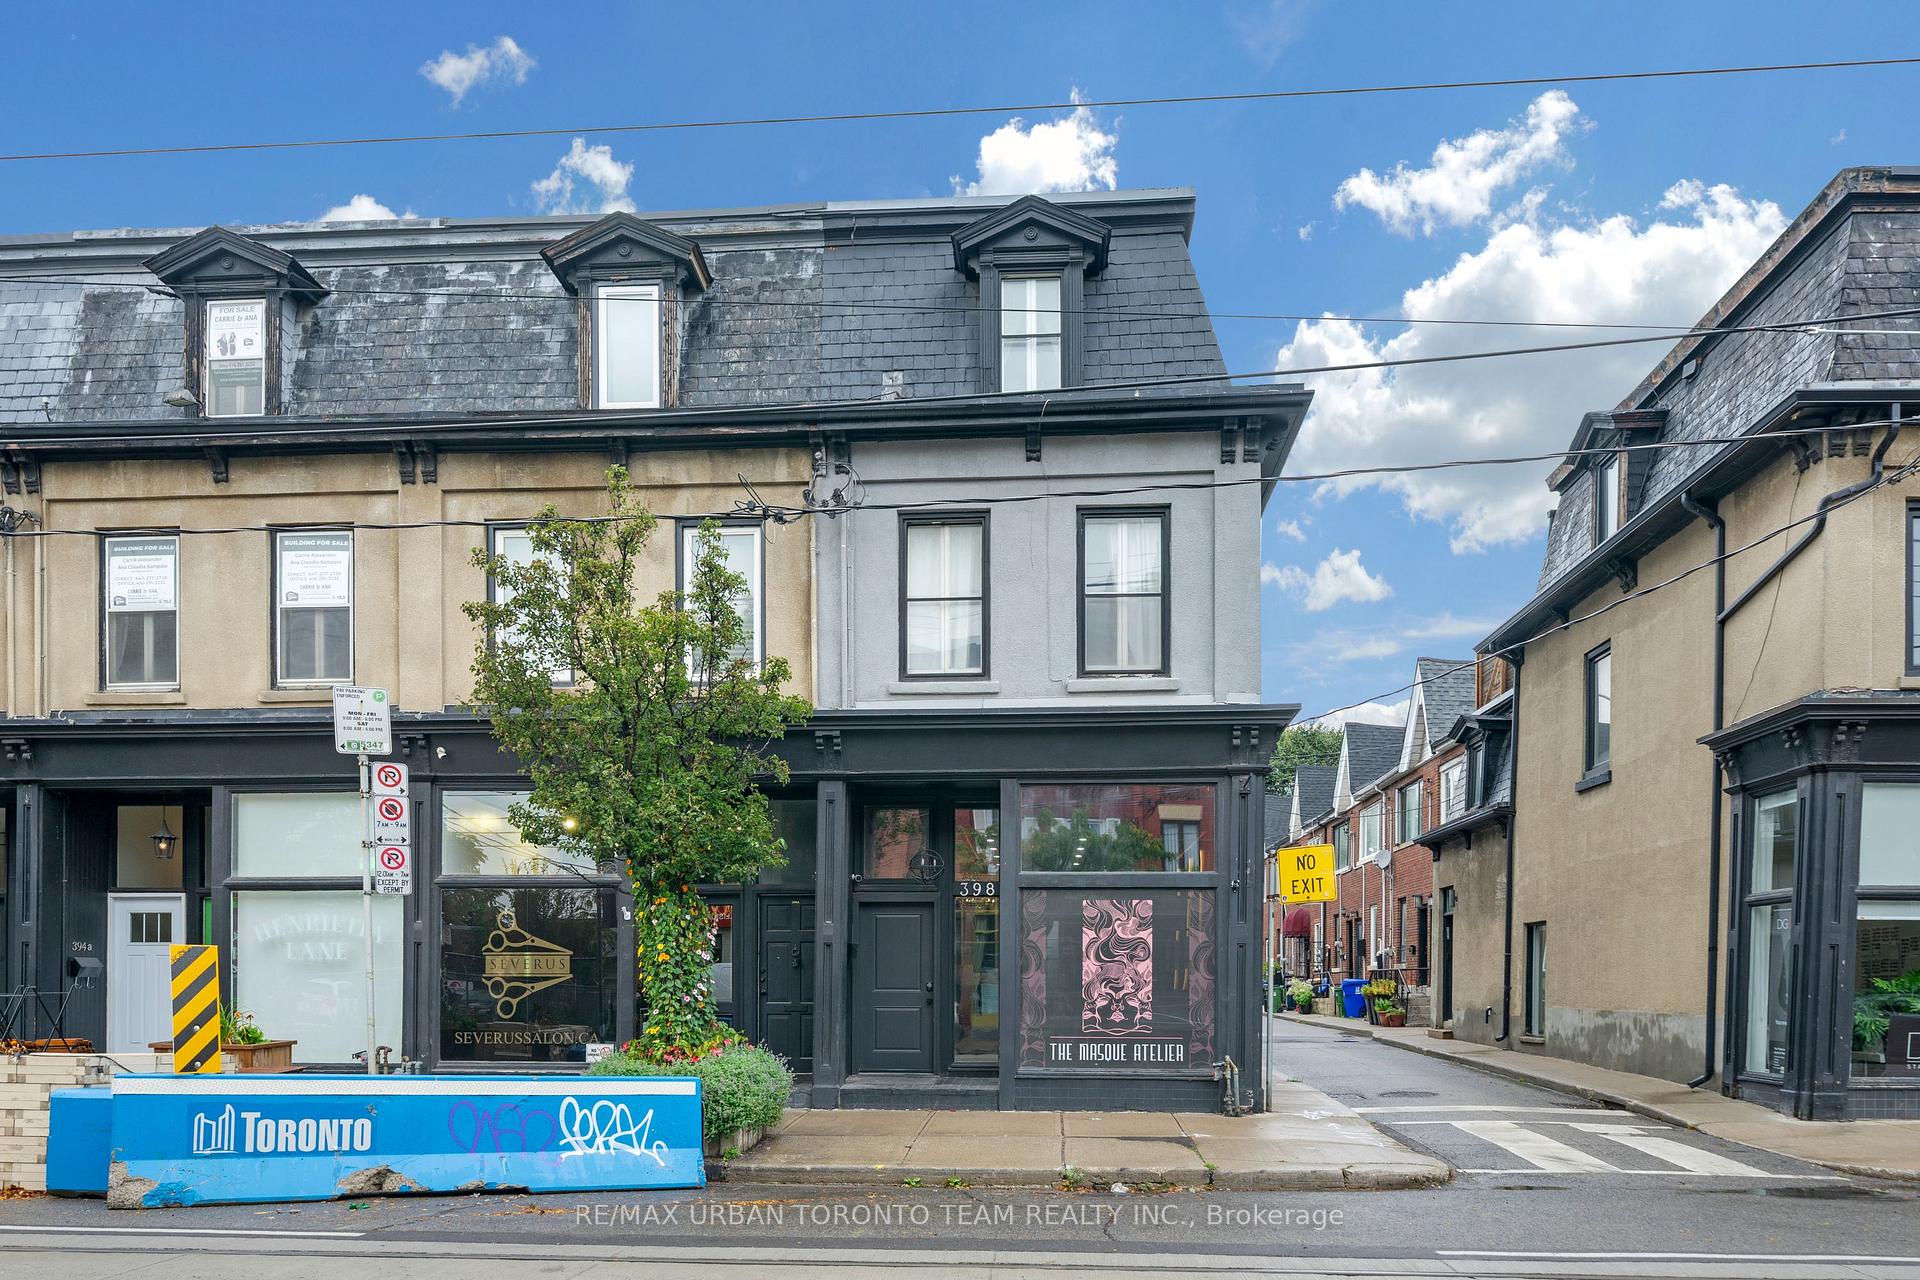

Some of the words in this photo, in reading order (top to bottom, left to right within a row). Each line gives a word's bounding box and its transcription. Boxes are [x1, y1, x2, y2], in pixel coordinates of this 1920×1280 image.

[1296, 854, 1316, 871] NO
[960, 882, 995, 896] 398
[1292, 878, 1323, 895] EXIT
[72, 941, 92, 951] 394a
[286, 942, 346, 960] LANE
[490, 958, 566, 970] SEVERUS
[454, 1031, 600, 1044] SEVERUSSALON.CA
[1050, 1043, 1072, 1061] THE
[1079, 1043, 1127, 1062] MASQUE
[1134, 1044, 1184, 1062] ATELIER
[240, 1111, 372, 1152] TORONTO
